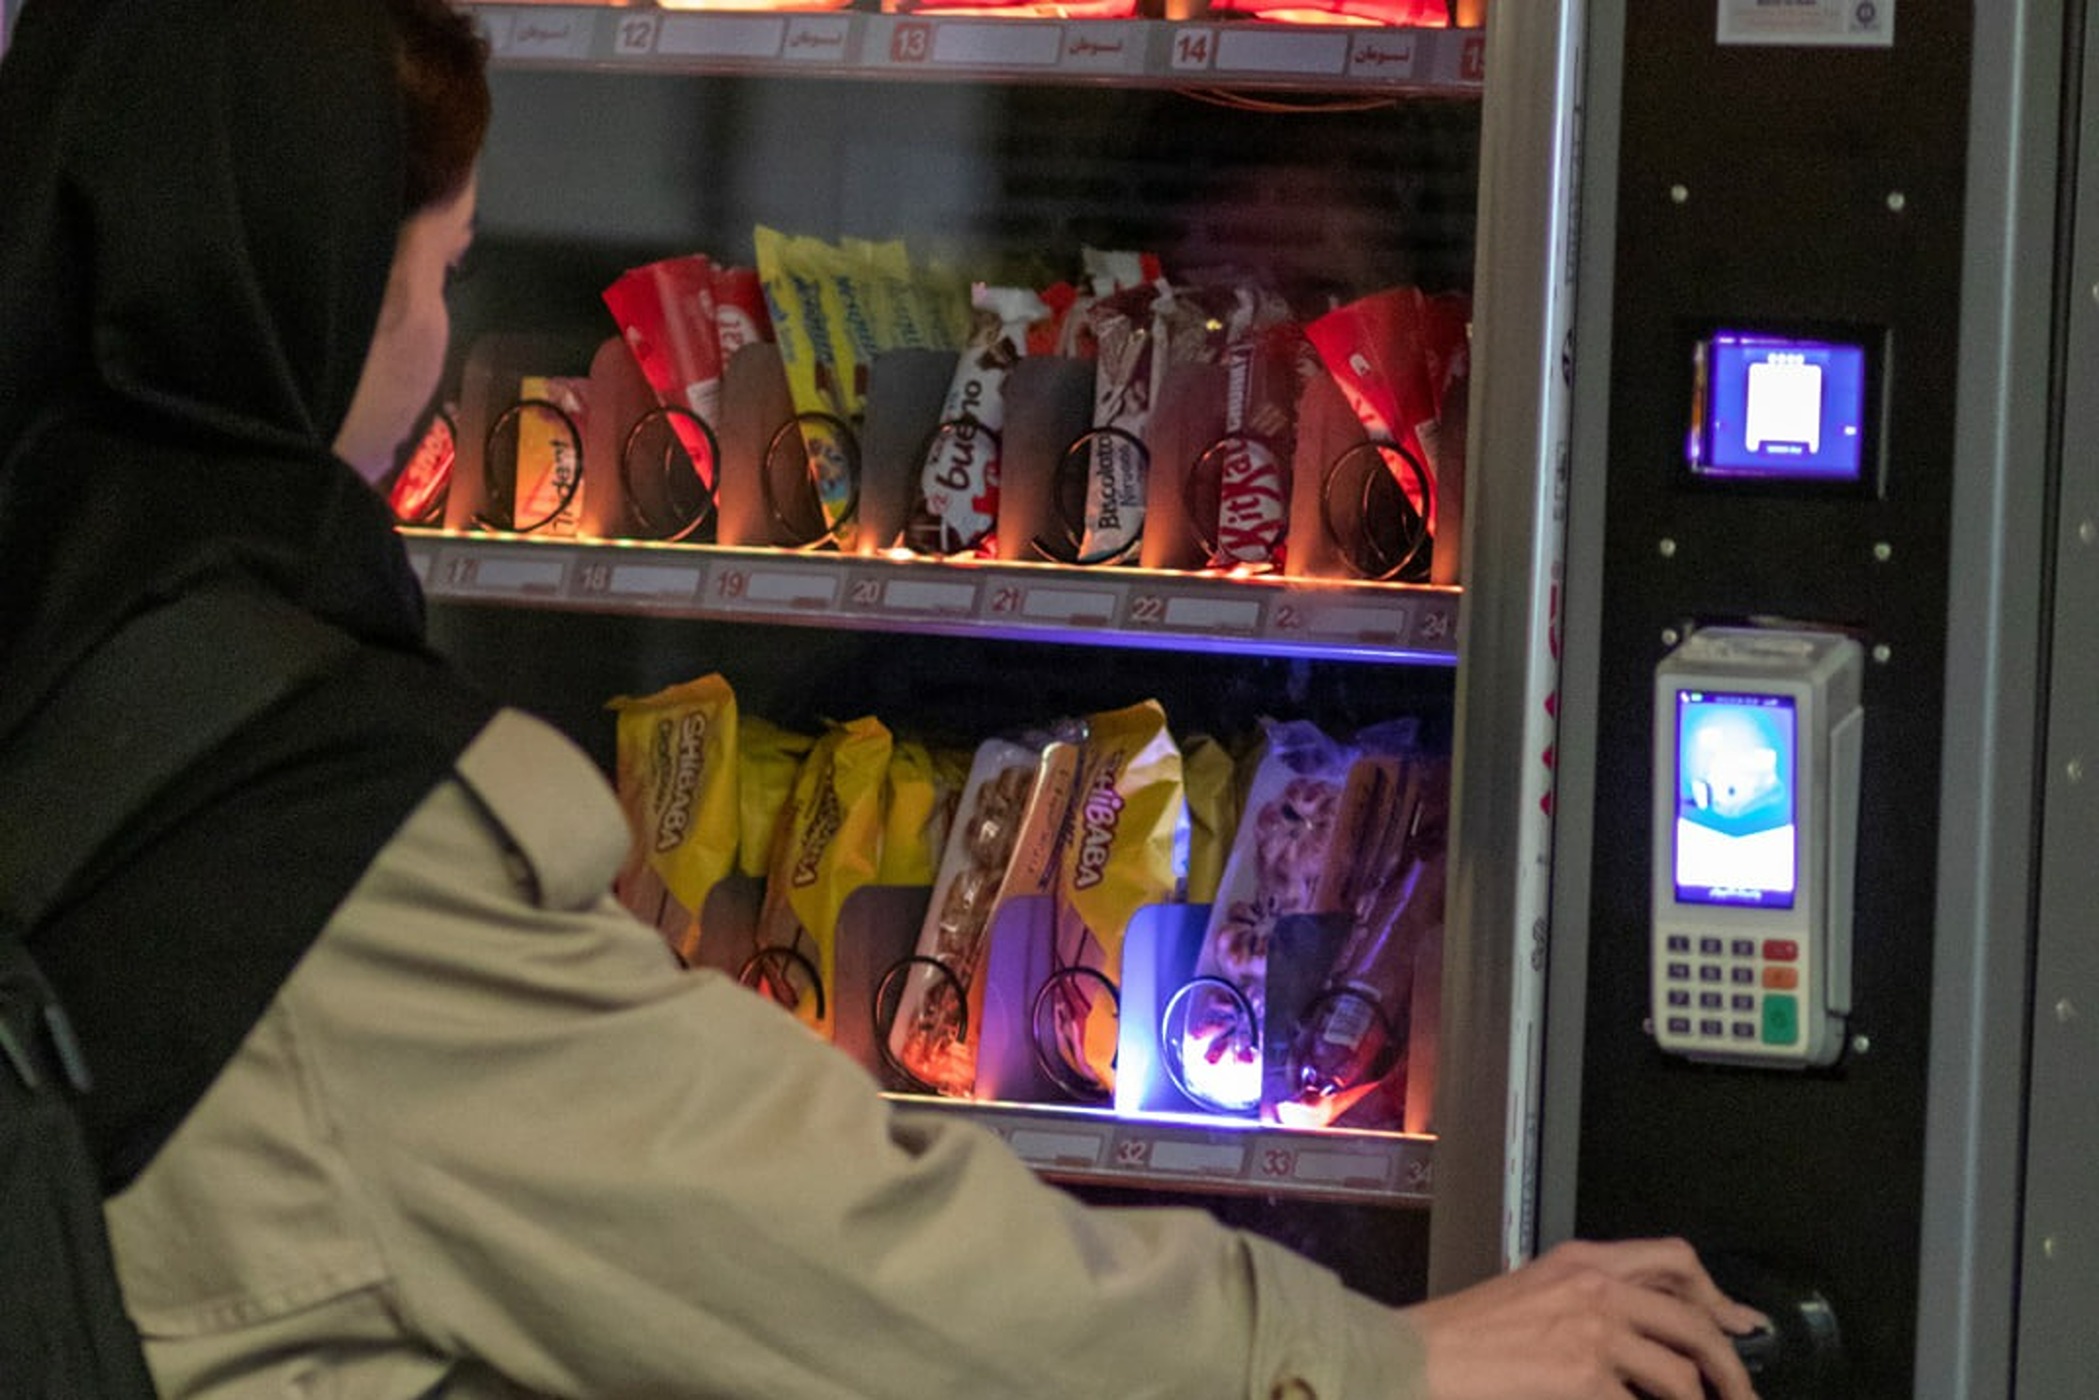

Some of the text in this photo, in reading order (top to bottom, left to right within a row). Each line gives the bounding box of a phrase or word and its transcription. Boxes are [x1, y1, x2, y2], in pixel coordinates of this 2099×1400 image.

[621, 22, 650, 48] 12
[896, 29, 926, 56] 13
[1176, 35, 1207, 62] 14
[935, 379, 982, 492] bueno
[716, 570, 744, 598] 19
[852, 579, 880, 604] 20
[992, 587, 1019, 612] 21
[1131, 595, 1163, 622] 22
[1117, 1140, 1147, 1165] 32
[1262, 1148, 1291, 1176] 33
